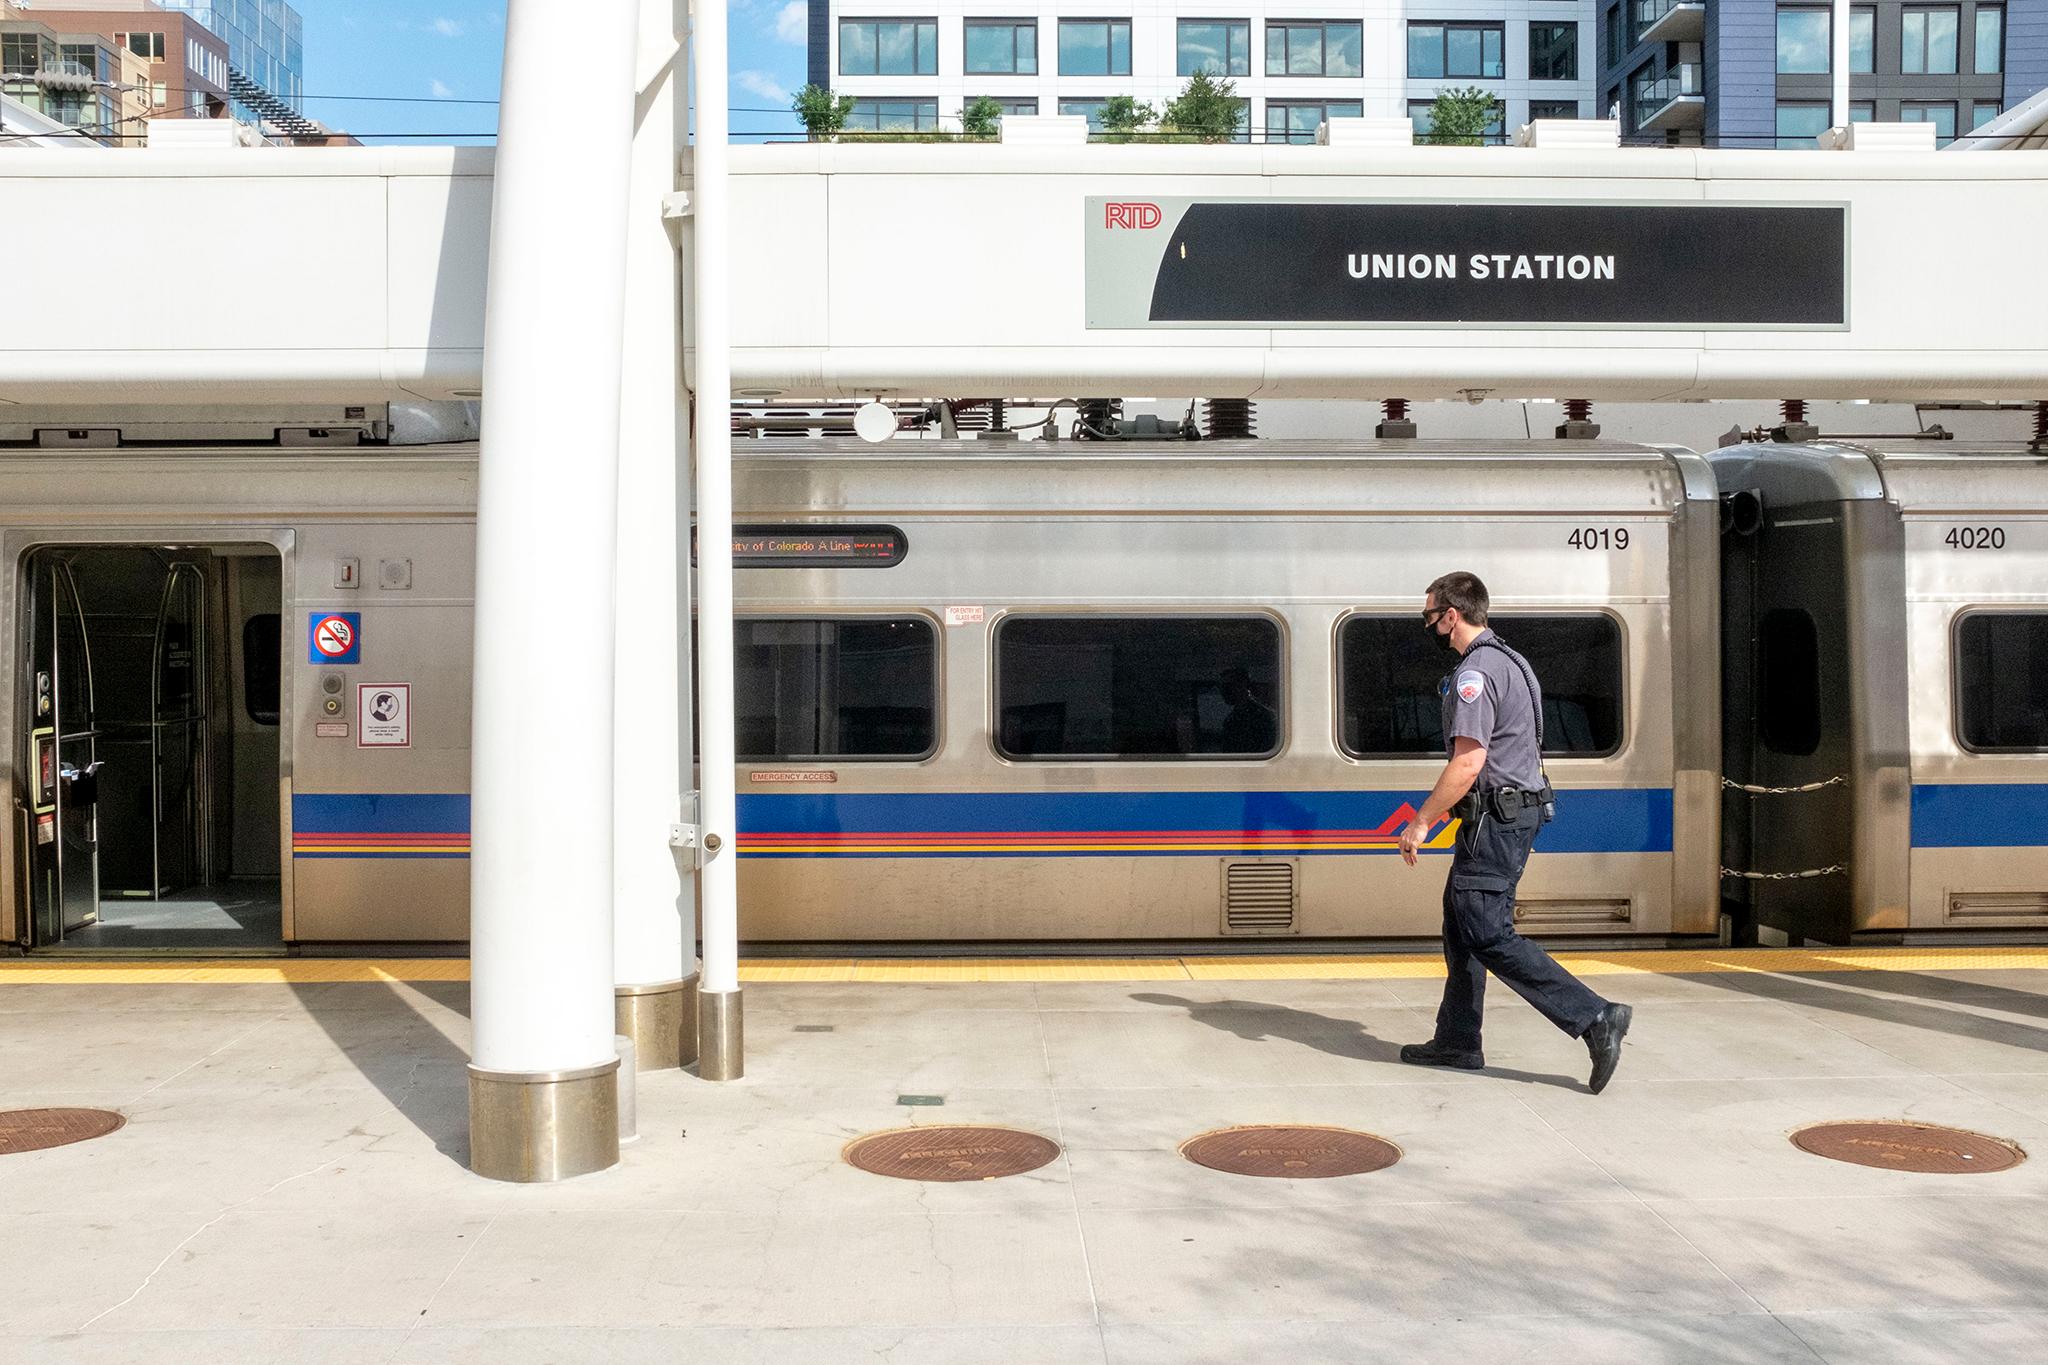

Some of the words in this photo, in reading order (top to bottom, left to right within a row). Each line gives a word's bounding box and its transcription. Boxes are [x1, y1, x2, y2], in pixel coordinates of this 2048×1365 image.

[1105, 203, 1162, 229] RTD
[1347, 253, 1457, 279] UNION
[1469, 253, 1615, 280] STATION
[753, 541, 765, 551] of
[768, 541, 814, 551] Colorado
[818, 541, 828, 551] A
[830, 541, 851, 551] Line
[1567, 527, 1629, 550] 4019
[1945, 527, 2006, 550] 4020
